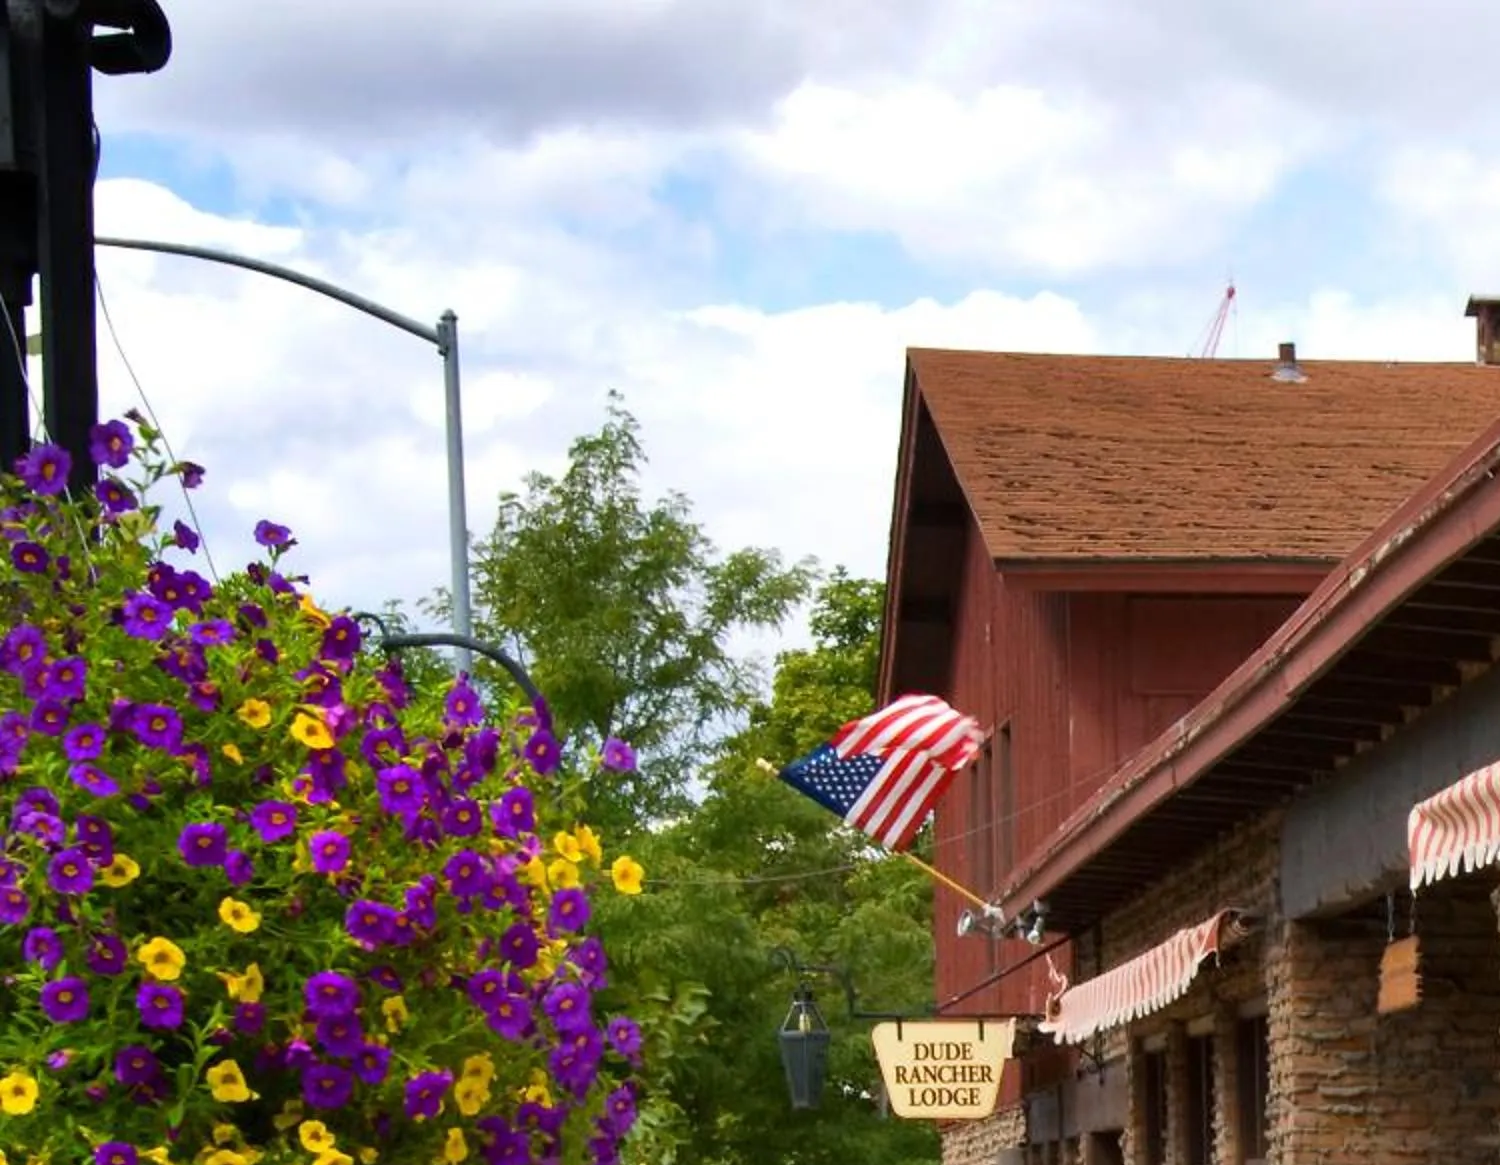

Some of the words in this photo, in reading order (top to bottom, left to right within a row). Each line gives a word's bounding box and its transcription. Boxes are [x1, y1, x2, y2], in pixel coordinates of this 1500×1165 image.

[913, 1042, 973, 1061] DUDE
[895, 1064, 994, 1084] RANCHER
[909, 1087, 981, 1107] LODGE
